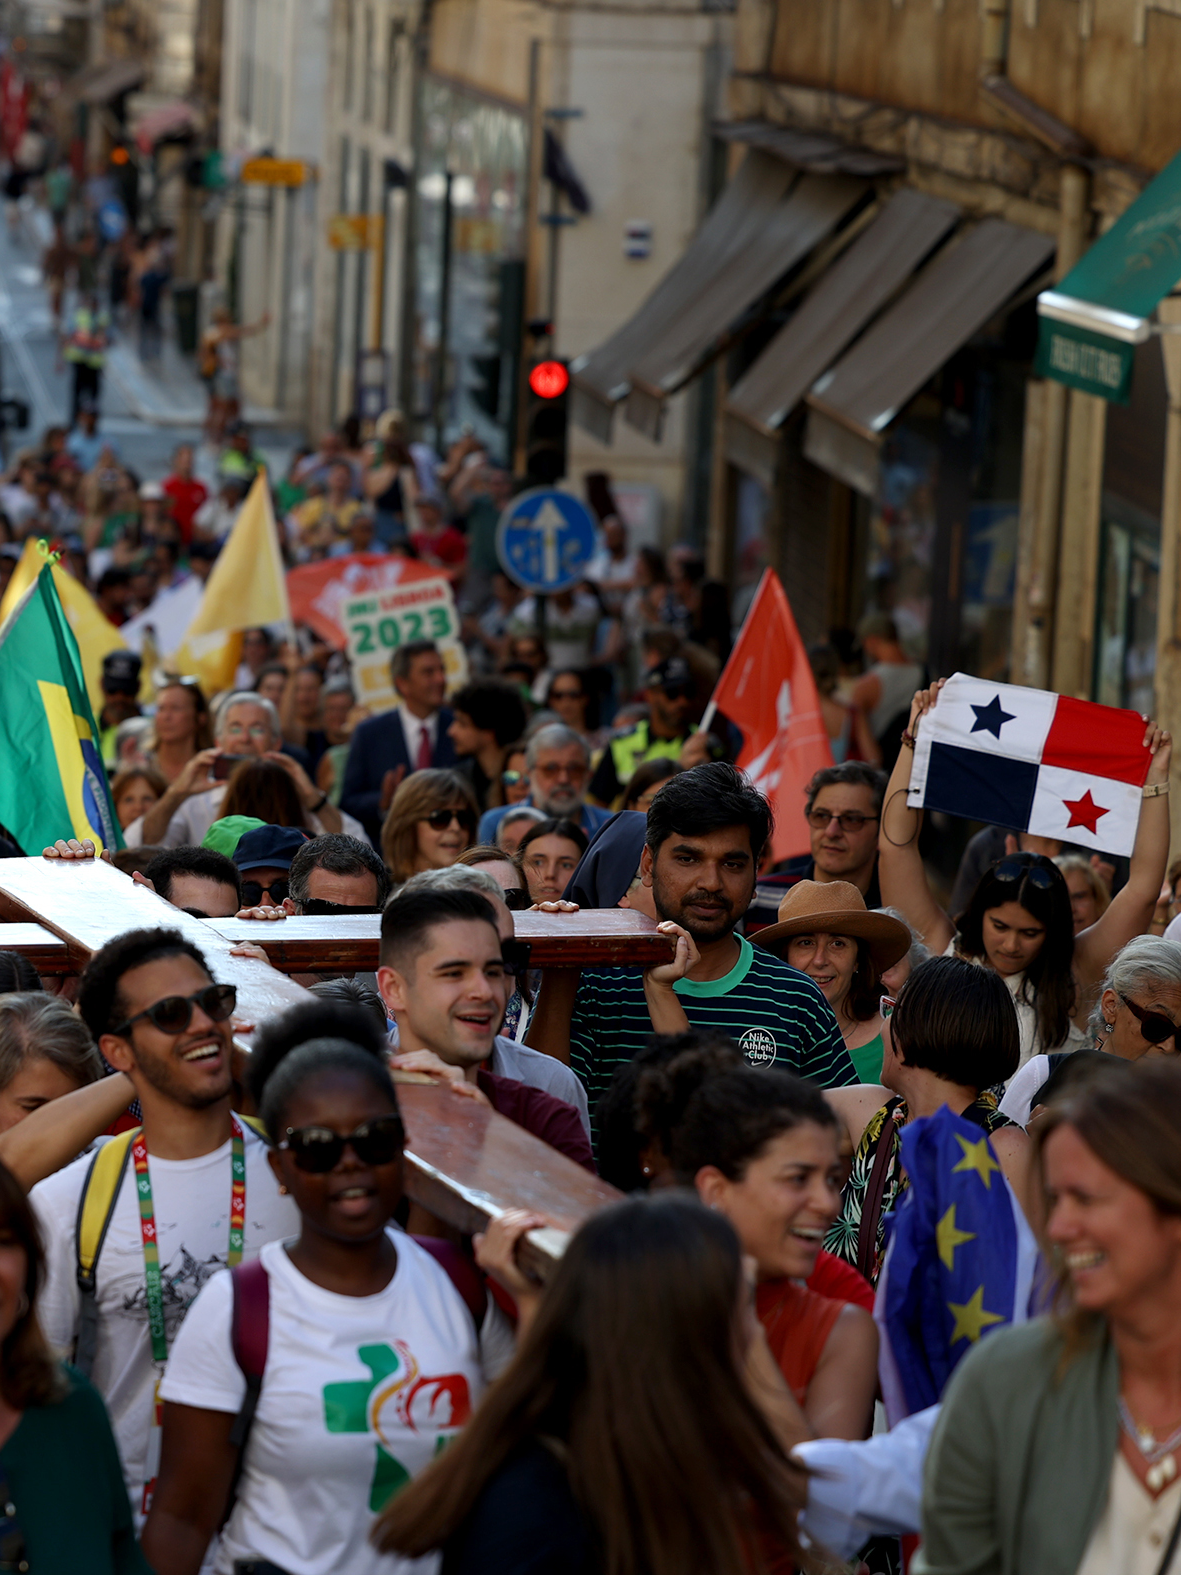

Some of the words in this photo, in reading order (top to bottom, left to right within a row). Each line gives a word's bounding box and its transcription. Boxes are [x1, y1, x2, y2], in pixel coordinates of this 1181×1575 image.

[351, 606, 451, 654] 2023
[749, 1032, 769, 1042] Nike
[742, 1041, 773, 1053] Athletic
[749, 1050, 768, 1060] Club
